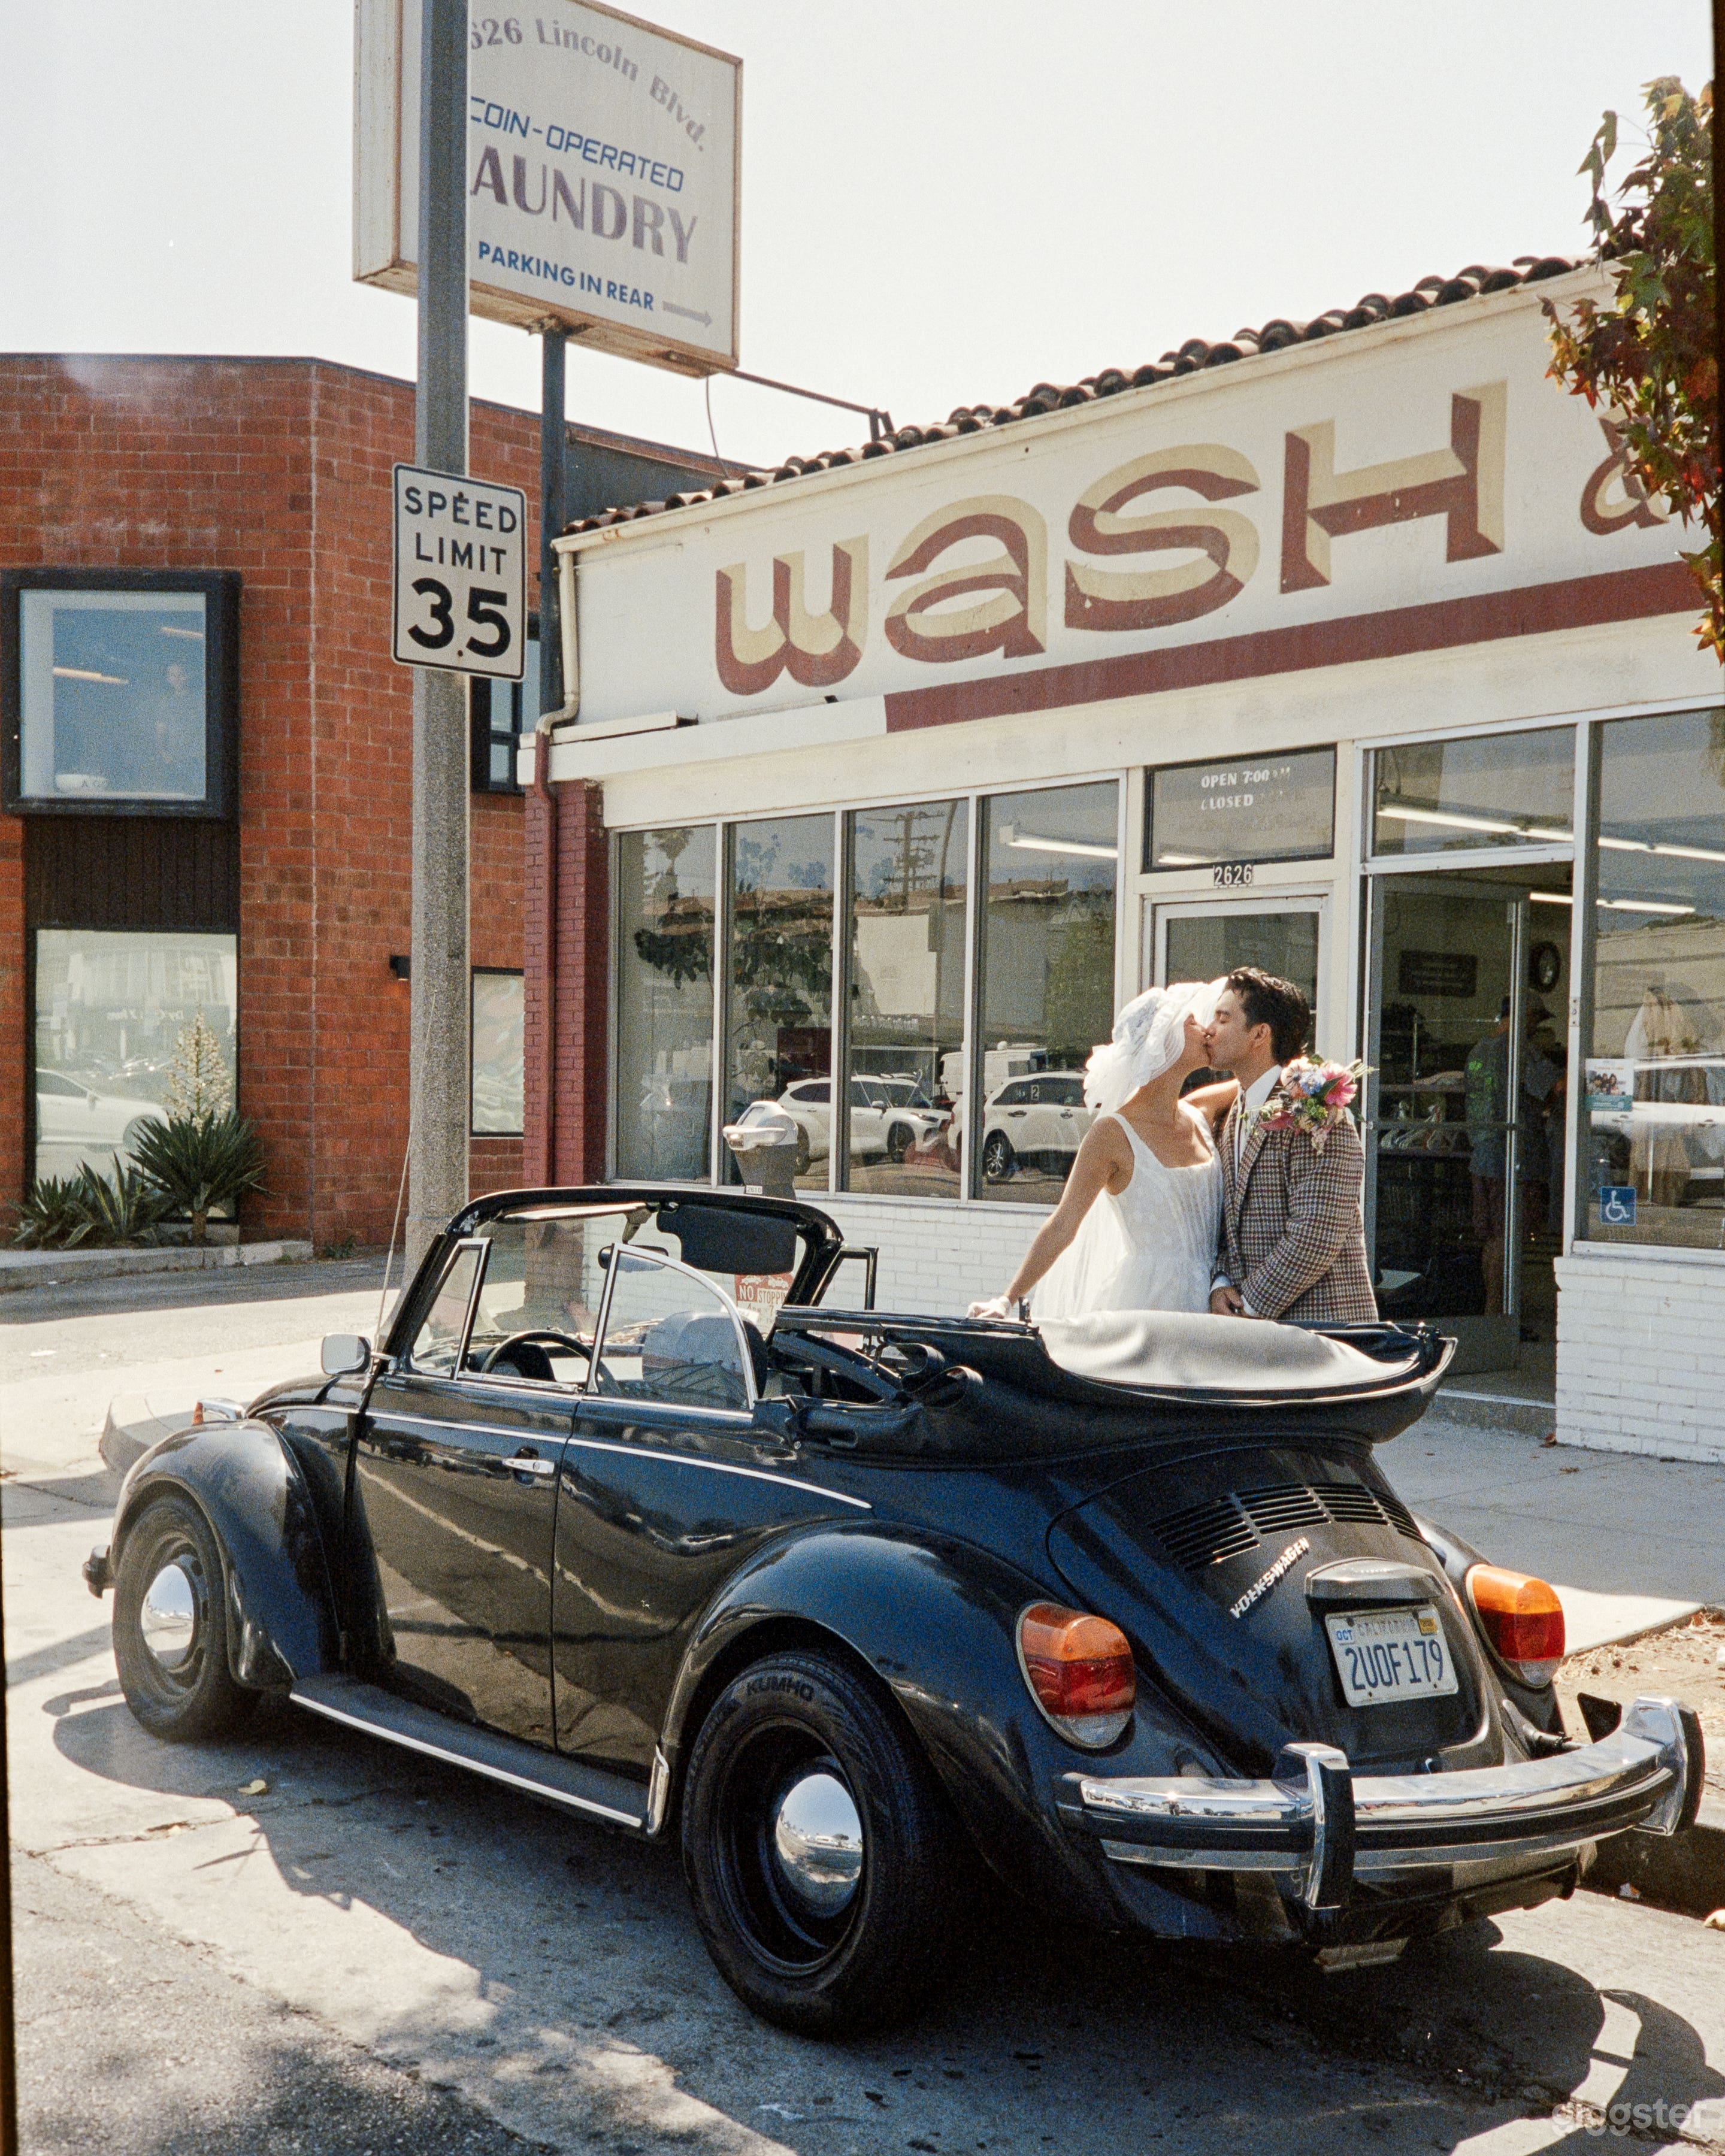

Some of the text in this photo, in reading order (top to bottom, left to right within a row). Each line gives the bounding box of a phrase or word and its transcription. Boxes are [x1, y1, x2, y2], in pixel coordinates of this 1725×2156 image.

[471, 17, 706, 152] 626 Lincoln Blvd.
[470, 145, 698, 264] AUNDRY
[479, 241, 654, 311] PARKING IN REAR
[404, 486, 517, 534] SPEED
[416, 532, 507, 575] LIMIT
[408, 577, 511, 658] 35
[1201, 773, 1237, 788] OPEN
[1215, 864, 1252, 885] 2626
[739, 1285, 754, 1301] NO
[1230, 1537, 1310, 1619] VOLKSWAGEN
[1336, 1629, 1352, 1641] OCT
[746, 1676, 815, 1702] KUMHO
